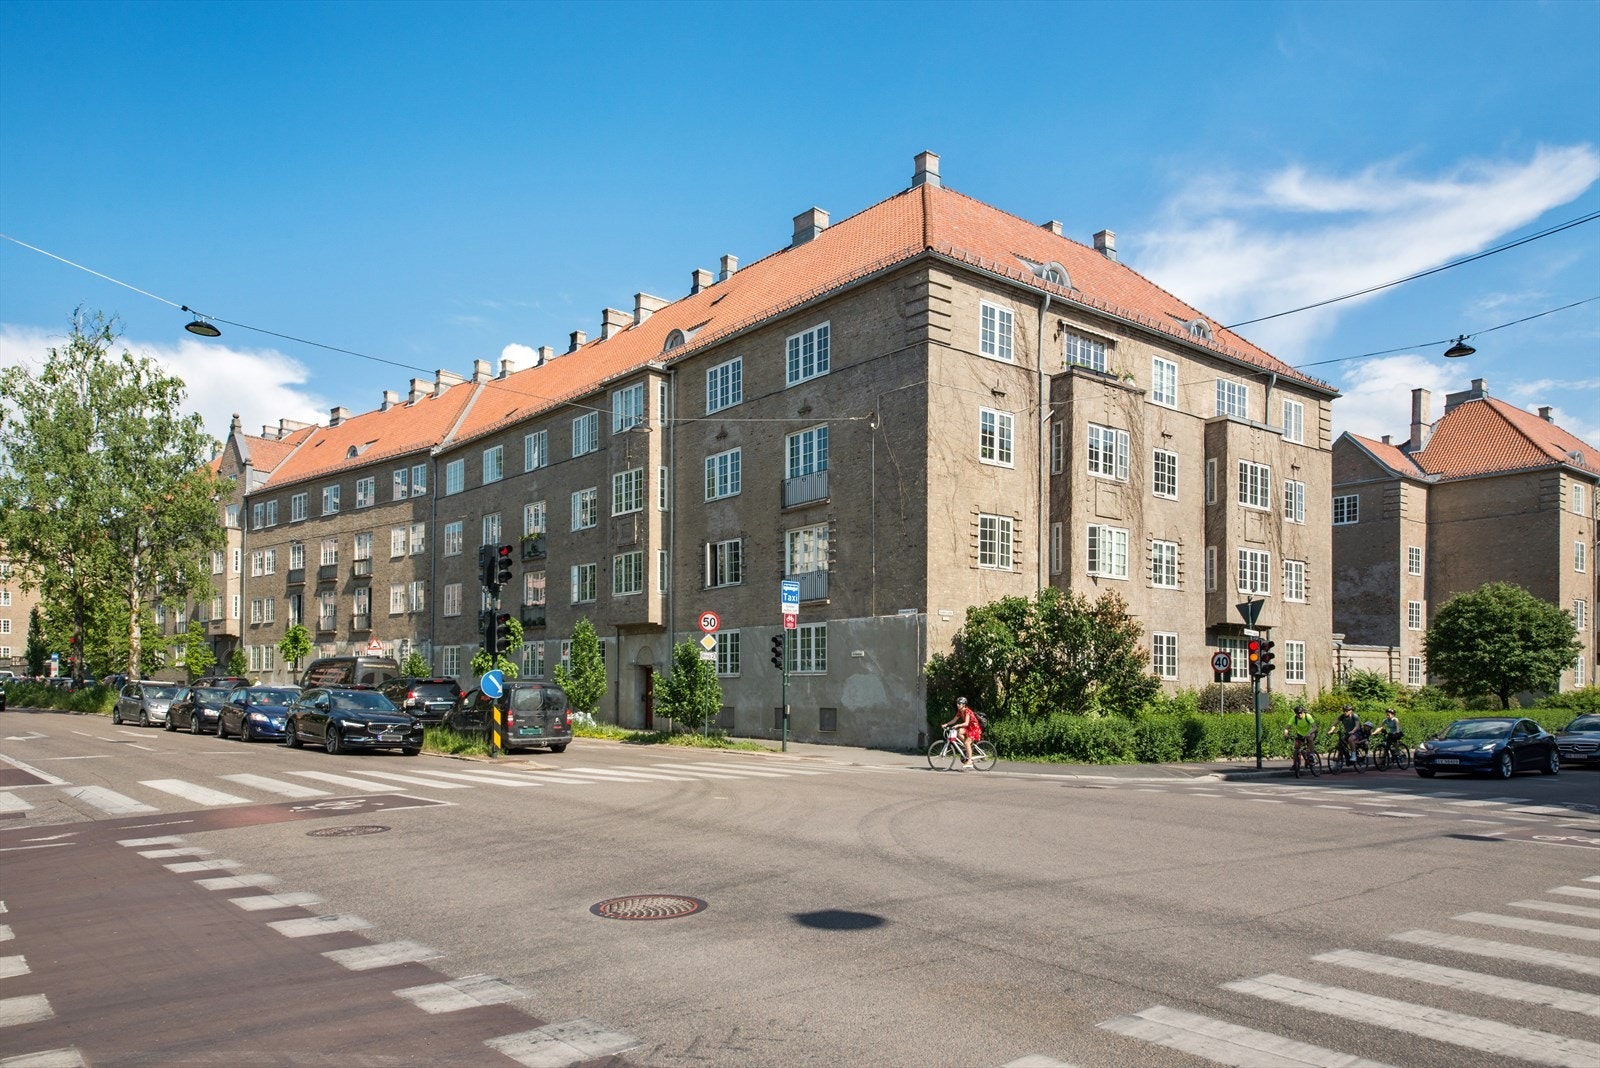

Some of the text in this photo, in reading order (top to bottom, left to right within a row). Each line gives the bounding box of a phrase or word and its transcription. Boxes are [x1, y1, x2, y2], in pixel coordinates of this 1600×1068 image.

[783, 593, 798, 602] Taxi
[703, 617, 716, 628] 50
[1215, 657, 1228, 667] 40
